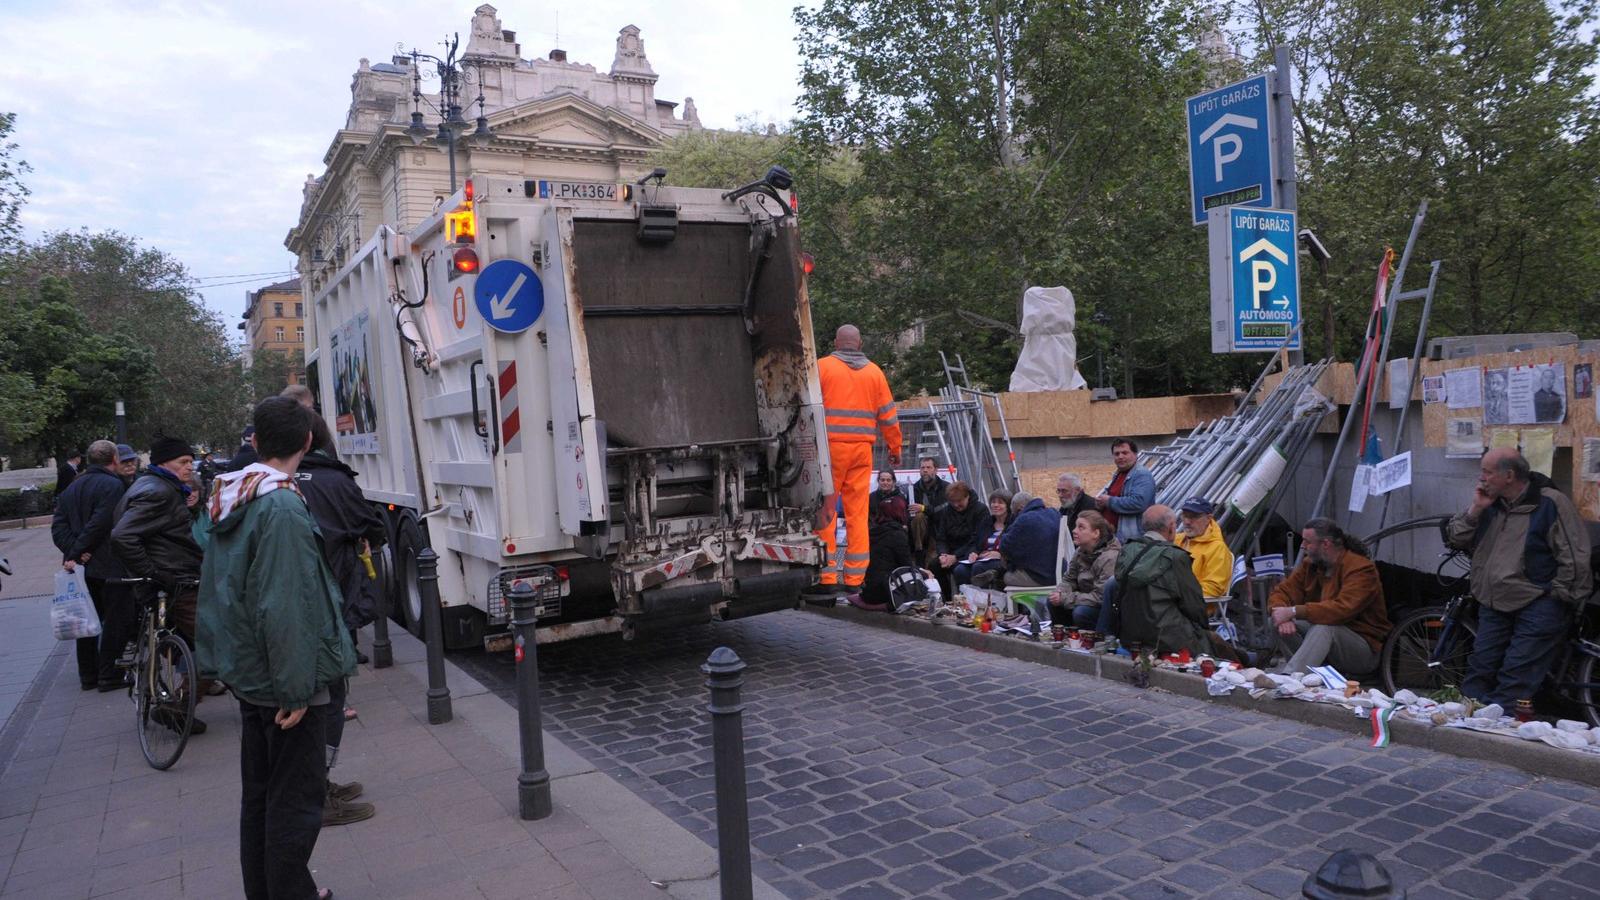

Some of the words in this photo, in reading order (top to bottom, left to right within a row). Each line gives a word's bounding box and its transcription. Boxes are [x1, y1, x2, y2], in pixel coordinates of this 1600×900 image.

[1193, 97, 1219, 115] LIPÓT
[1221, 84, 1260, 107] GARÁZS
[1213, 133, 1243, 182] P
[1235, 213, 1257, 230] LIPÓT
[1259, 215, 1290, 232] GARÁZS
[1252, 260, 1277, 309] P
